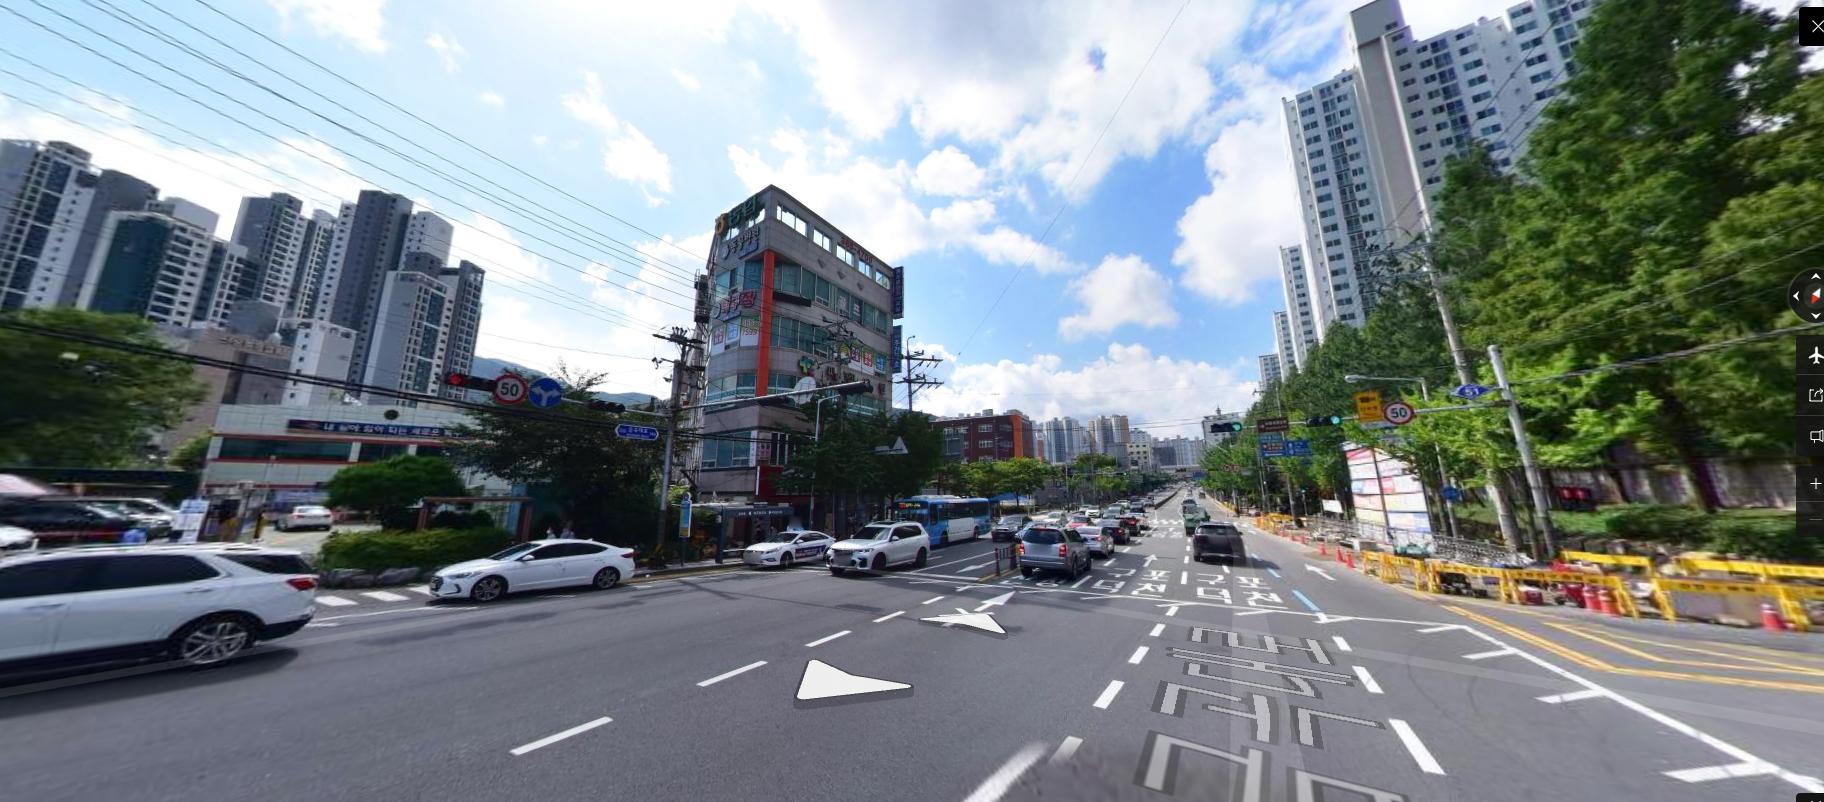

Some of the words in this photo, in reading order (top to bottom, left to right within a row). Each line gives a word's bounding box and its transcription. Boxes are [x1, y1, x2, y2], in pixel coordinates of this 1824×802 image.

[501, 383, 519, 397] 50
[1391, 407, 1407, 418] 50
[1196, 573, 1271, 590] 구포
[1196, 586, 1289, 610] 덕천
